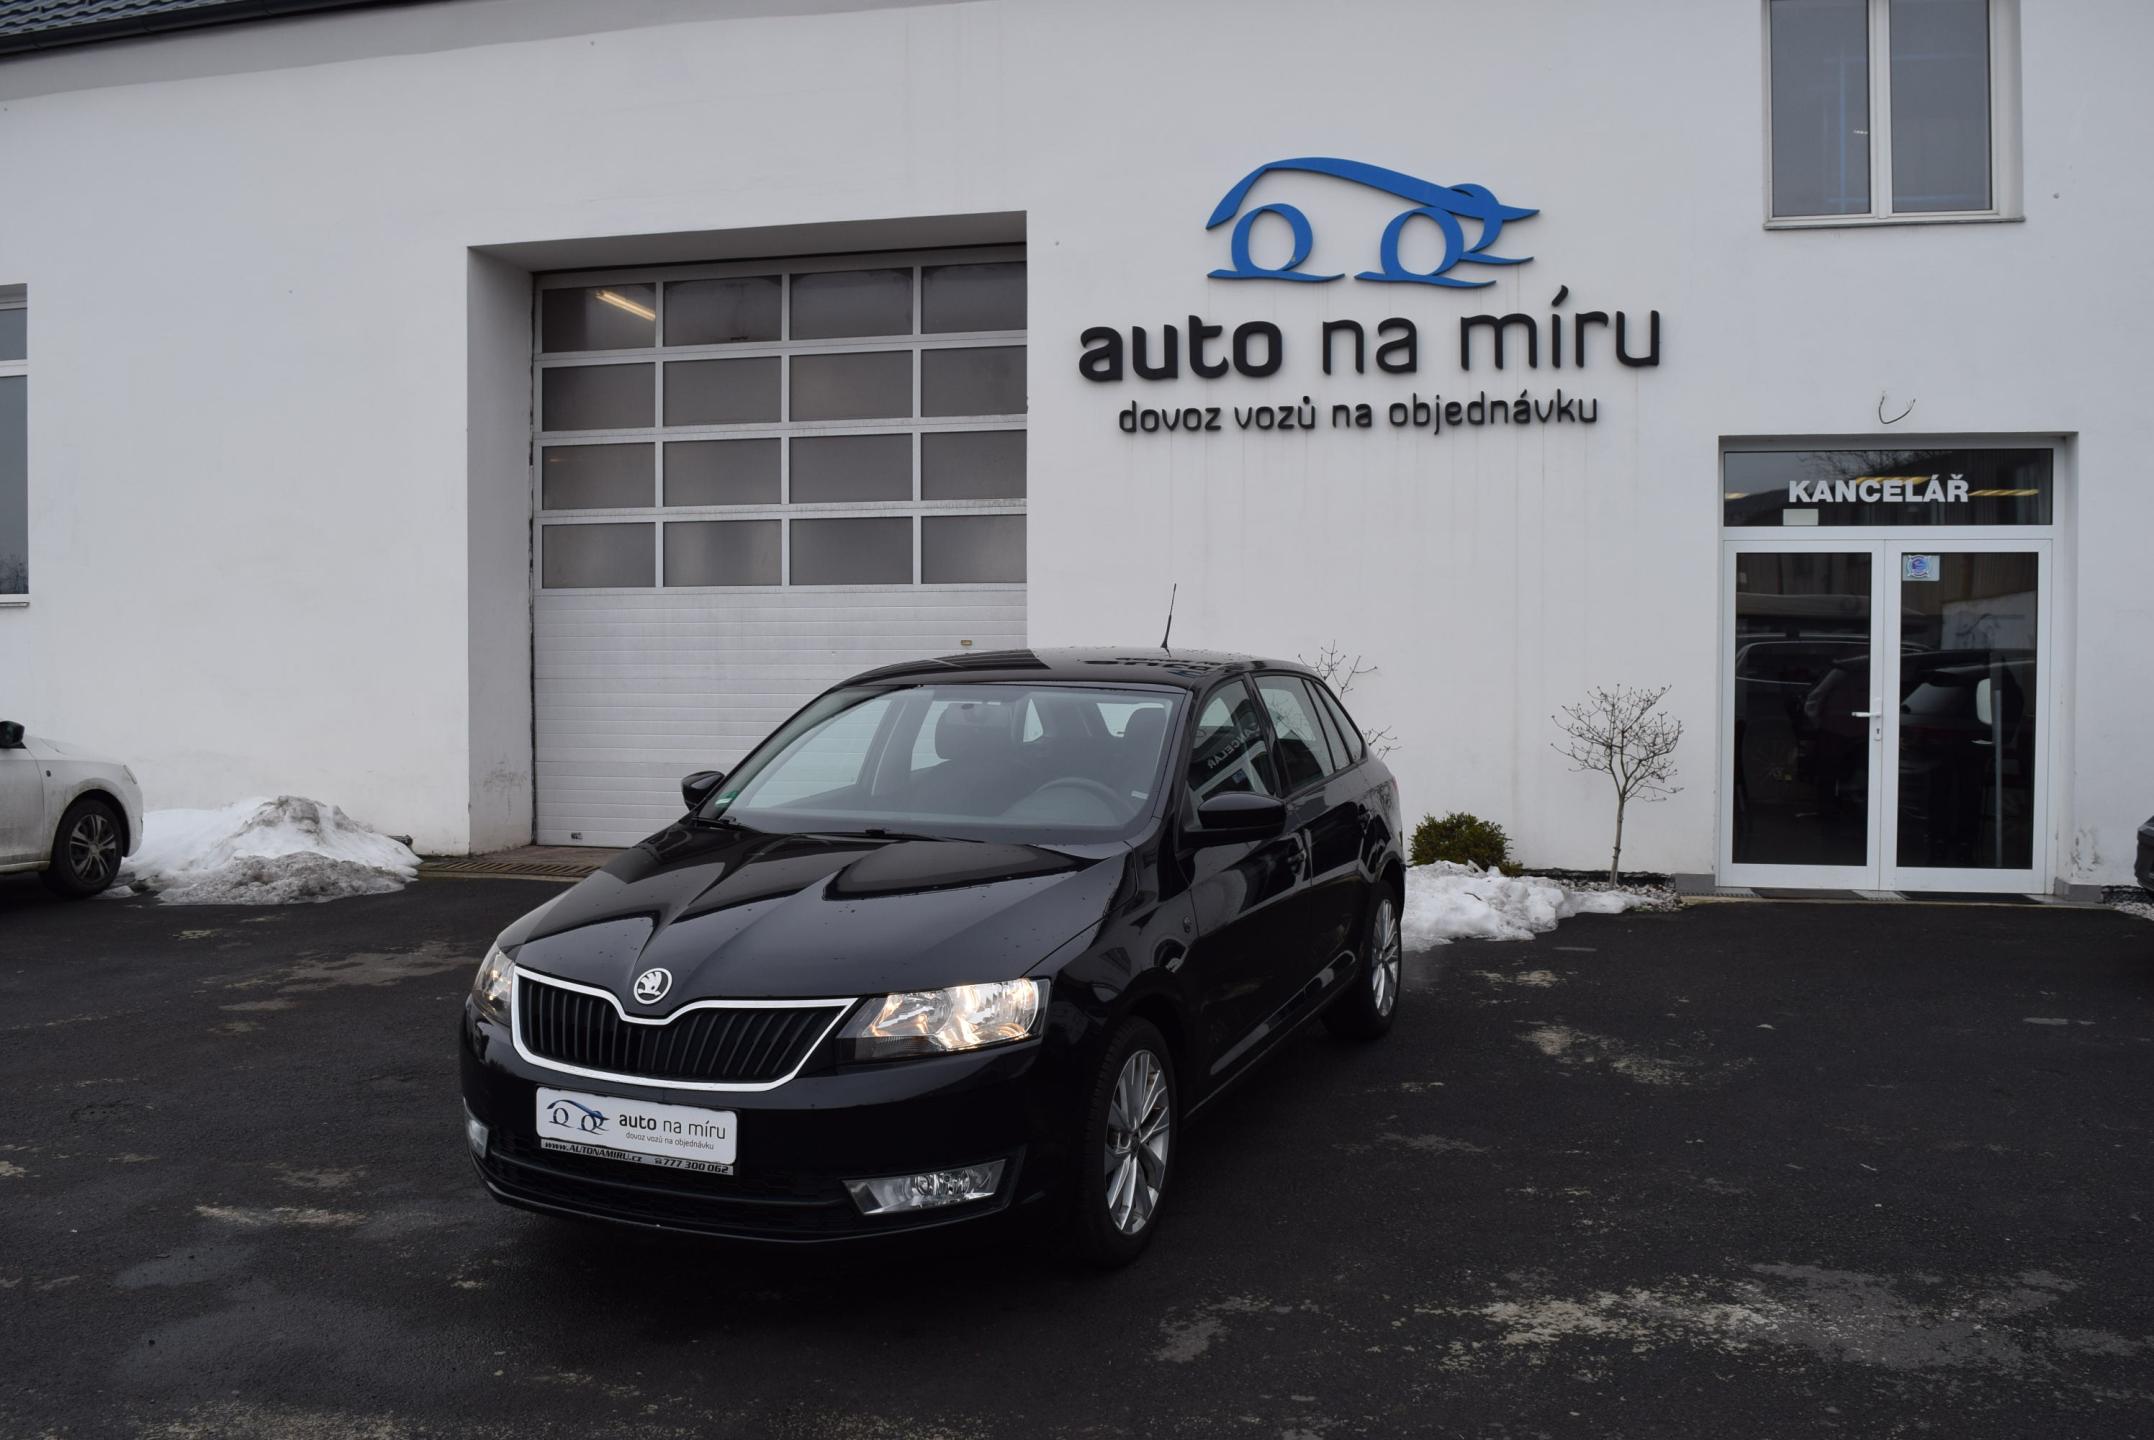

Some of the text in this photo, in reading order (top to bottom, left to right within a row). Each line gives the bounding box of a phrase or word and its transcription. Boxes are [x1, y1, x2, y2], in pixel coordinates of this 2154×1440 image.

[1078, 285, 1660, 382] auto na míru
[1118, 388, 1598, 436] dovoz vozů na objednávku
[1788, 474, 1969, 503] KANCELÁŘ
[619, 1114, 726, 1140] auto na míru
[625, 1131, 646, 1141] dovoz
[664, 1137, 674, 1145] na
[674, 1138, 714, 1150] objednávku
[663, 1158, 684, 1168] 777
[685, 1161, 706, 1171] 300
[708, 1164, 729, 1174] 062
